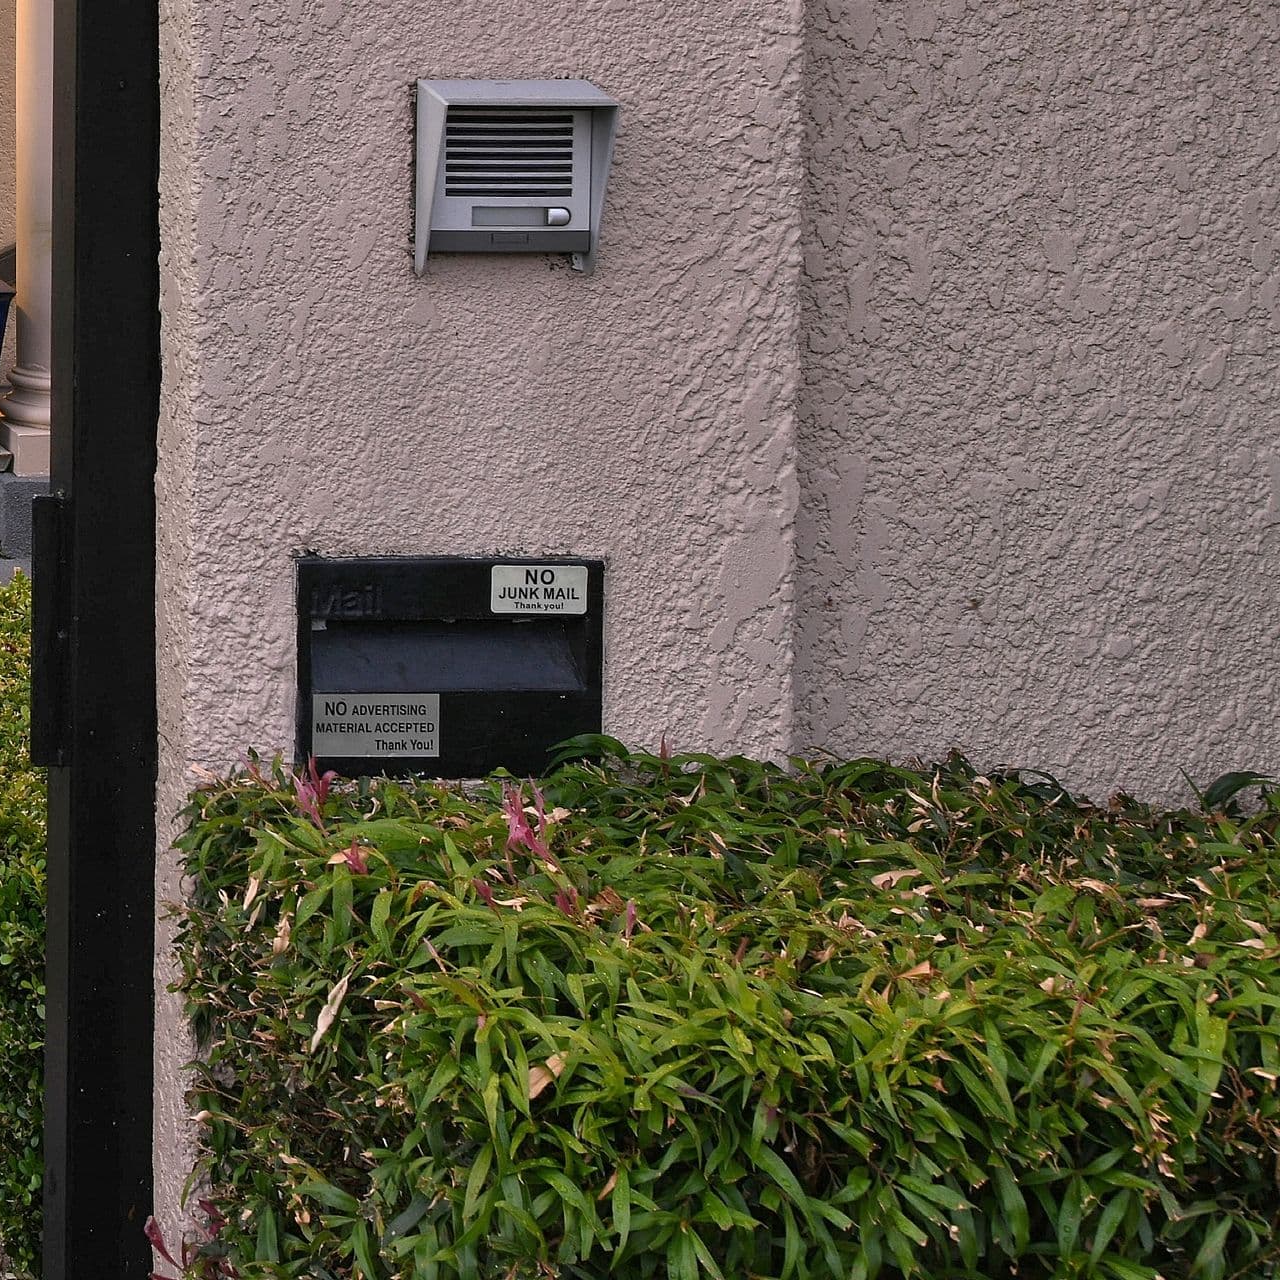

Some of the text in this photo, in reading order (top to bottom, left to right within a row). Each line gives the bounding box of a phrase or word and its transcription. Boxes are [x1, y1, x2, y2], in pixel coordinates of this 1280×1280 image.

[525, 569, 555, 585] NO
[498, 587, 579, 600] JUNK MAIL
[514, 601, 564, 611] Thank you!
[325, 701, 427, 716] NO ADVERTISING
[315, 722, 435, 733] MATERIAL ACCEPTED
[375, 739, 434, 750] Thank You!
